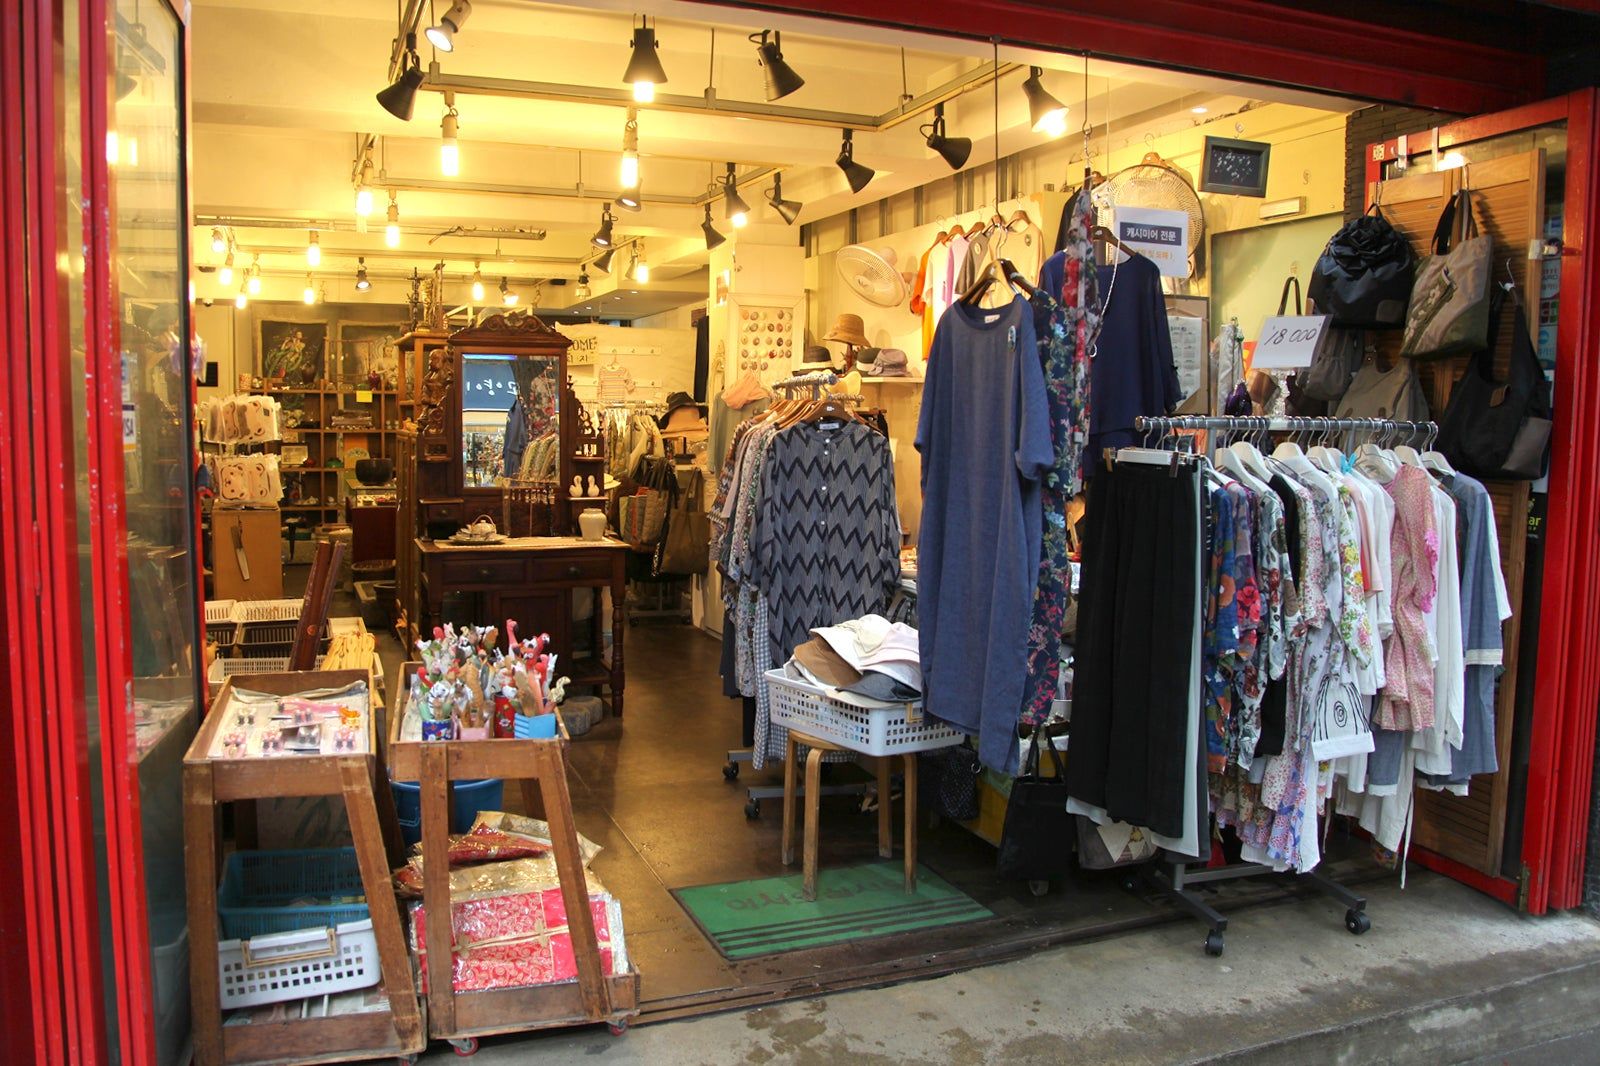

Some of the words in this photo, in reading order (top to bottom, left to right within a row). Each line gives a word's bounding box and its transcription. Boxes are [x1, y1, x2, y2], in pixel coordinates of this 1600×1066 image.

[1126, 227, 1159, 240] 캐시미어
[1160, 230, 1177, 242] 전문
[569, 338, 596, 351] OME
